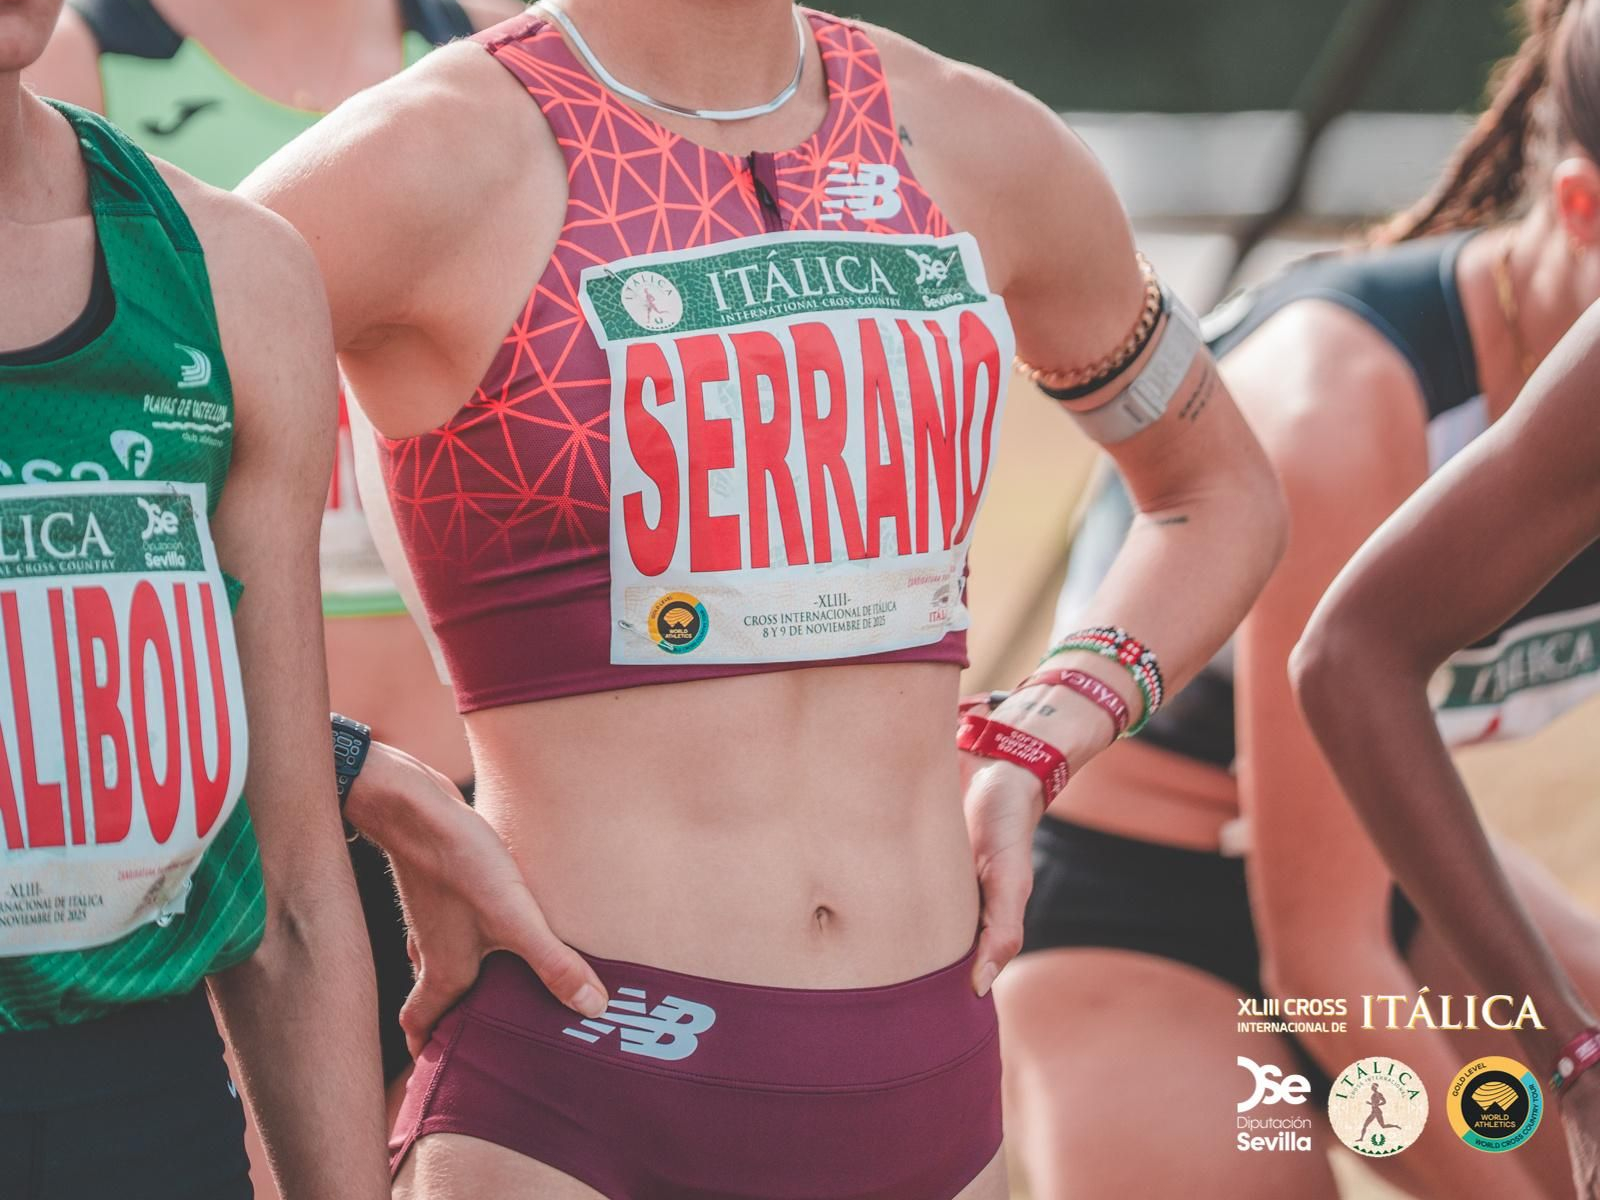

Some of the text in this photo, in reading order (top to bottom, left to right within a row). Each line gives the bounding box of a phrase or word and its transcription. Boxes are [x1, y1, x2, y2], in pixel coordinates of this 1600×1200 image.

[707, 250, 898, 311] ITÁLICA
[720, 296, 900, 323] INTERNATIONAL CROSS COUNTRY
[622, 310, 1001, 577] SERRANO
[16, 561, 55, 576] CROSS
[58, 559, 117, 572] COUNTRY
[144, 551, 186, 569] Sevilla
[743, 600, 897, 627] CROSS INTERNACIONAL DE ITÁLICA
[762, 627, 769, 638] 8
[771, 627, 778, 637] Y
[780, 626, 787, 636] 9
[789, 625, 802, 636] DE
[806, 620, 860, 634] NOVIEMBRE
[862, 619, 872, 629] DE
